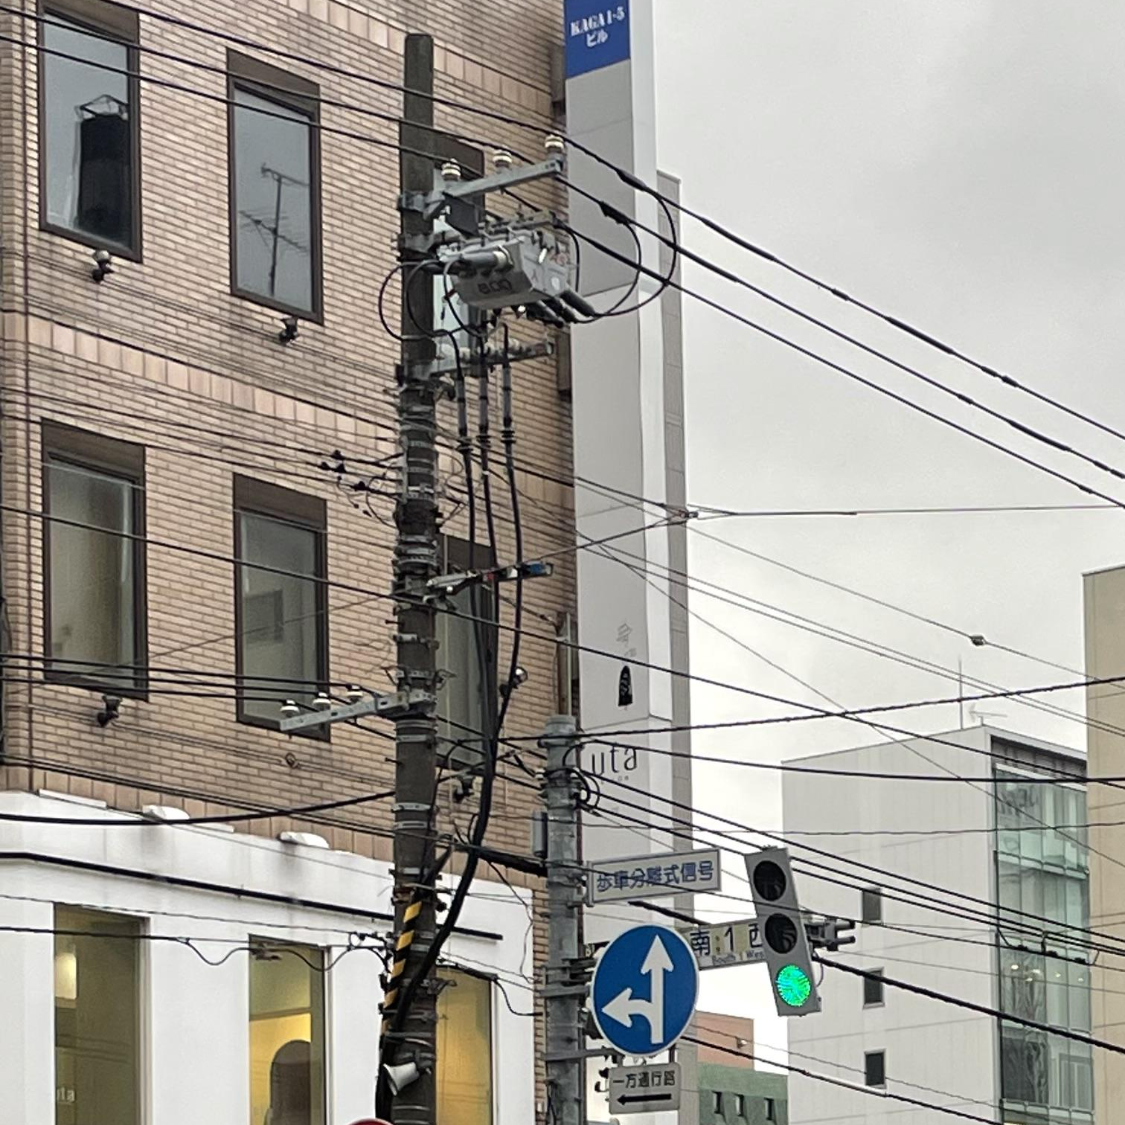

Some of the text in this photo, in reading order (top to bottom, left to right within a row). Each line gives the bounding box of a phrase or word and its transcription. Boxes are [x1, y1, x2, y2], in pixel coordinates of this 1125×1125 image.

[597, 860, 715, 892] 歩車分離式信号
[612, 1070, 676, 1089] 一方通行路
